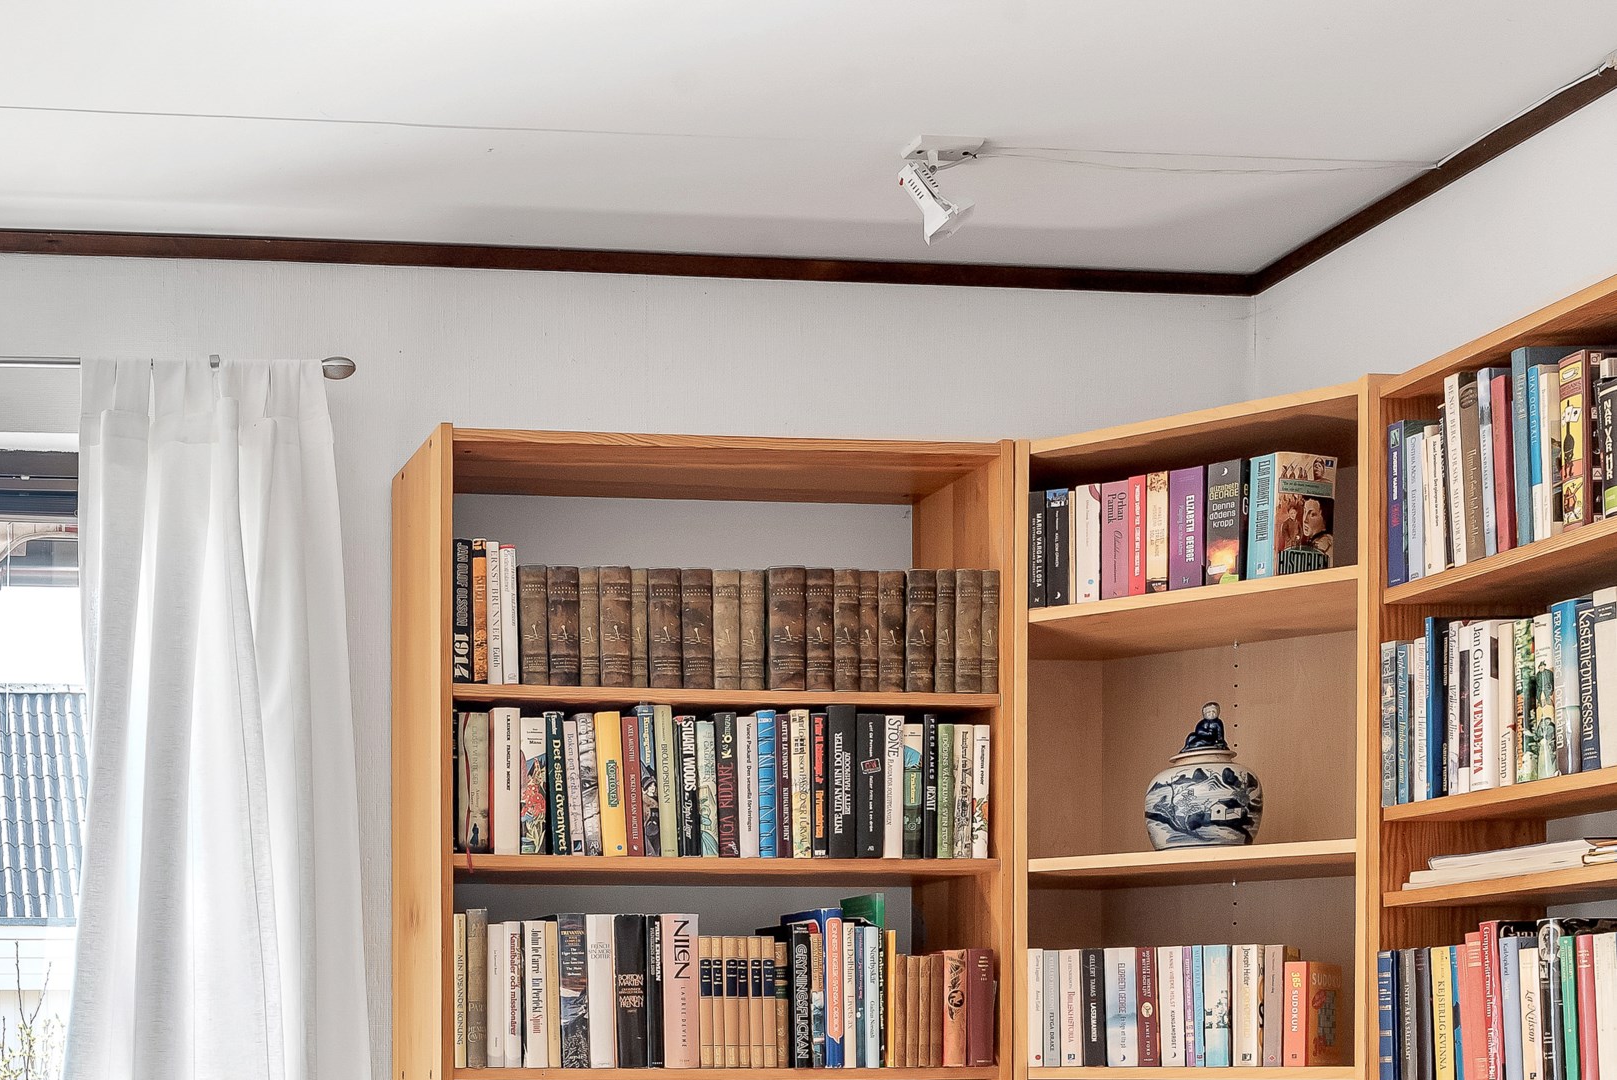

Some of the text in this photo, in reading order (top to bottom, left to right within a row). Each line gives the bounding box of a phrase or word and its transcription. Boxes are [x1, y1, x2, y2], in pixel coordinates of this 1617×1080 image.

[1107, 494, 1116, 524] Pamuk
[1117, 492, 1127, 521] Orhan
[1209, 510, 1236, 520] dödens
[1212, 502, 1235, 511] Denna
[1186, 495, 1195, 562] ELIZABETH GEORGE
[1212, 519, 1234, 529] kropp
[490, 550, 498, 586] ERNST
[454, 542, 469, 679] JAN OLOF OLSSON 1914
[491, 588, 500, 641] BRUNNER
[1578, 608, 1597, 742] Kastanjeprinsessan
[1472, 626, 1484, 775] Jan Guillou VENDETTA
[834, 732, 842, 766] DOTTER
[887, 718, 900, 758] STONE
[682, 721, 696, 791] STUART WOODS
[661, 744, 670, 803] BRÖLLOPSRESAN
[553, 740, 567, 851] Det sista äventyret
[631, 794, 636, 803] OM
[835, 813, 843, 834] INTE
[531, 928, 542, 946] John
[674, 920, 690, 979] NILEN
[531, 954, 542, 973] Carré
[1291, 972, 1301, 988] 365
[532, 978, 542, 987] En
[532, 989, 542, 1013] Perfekt
[796, 944, 809, 1059] GRYNINGSFLICKAN
[530, 1014, 542, 1034] Spion
[1436, 980, 1448, 1071] KEJSERLIG KVINNA
